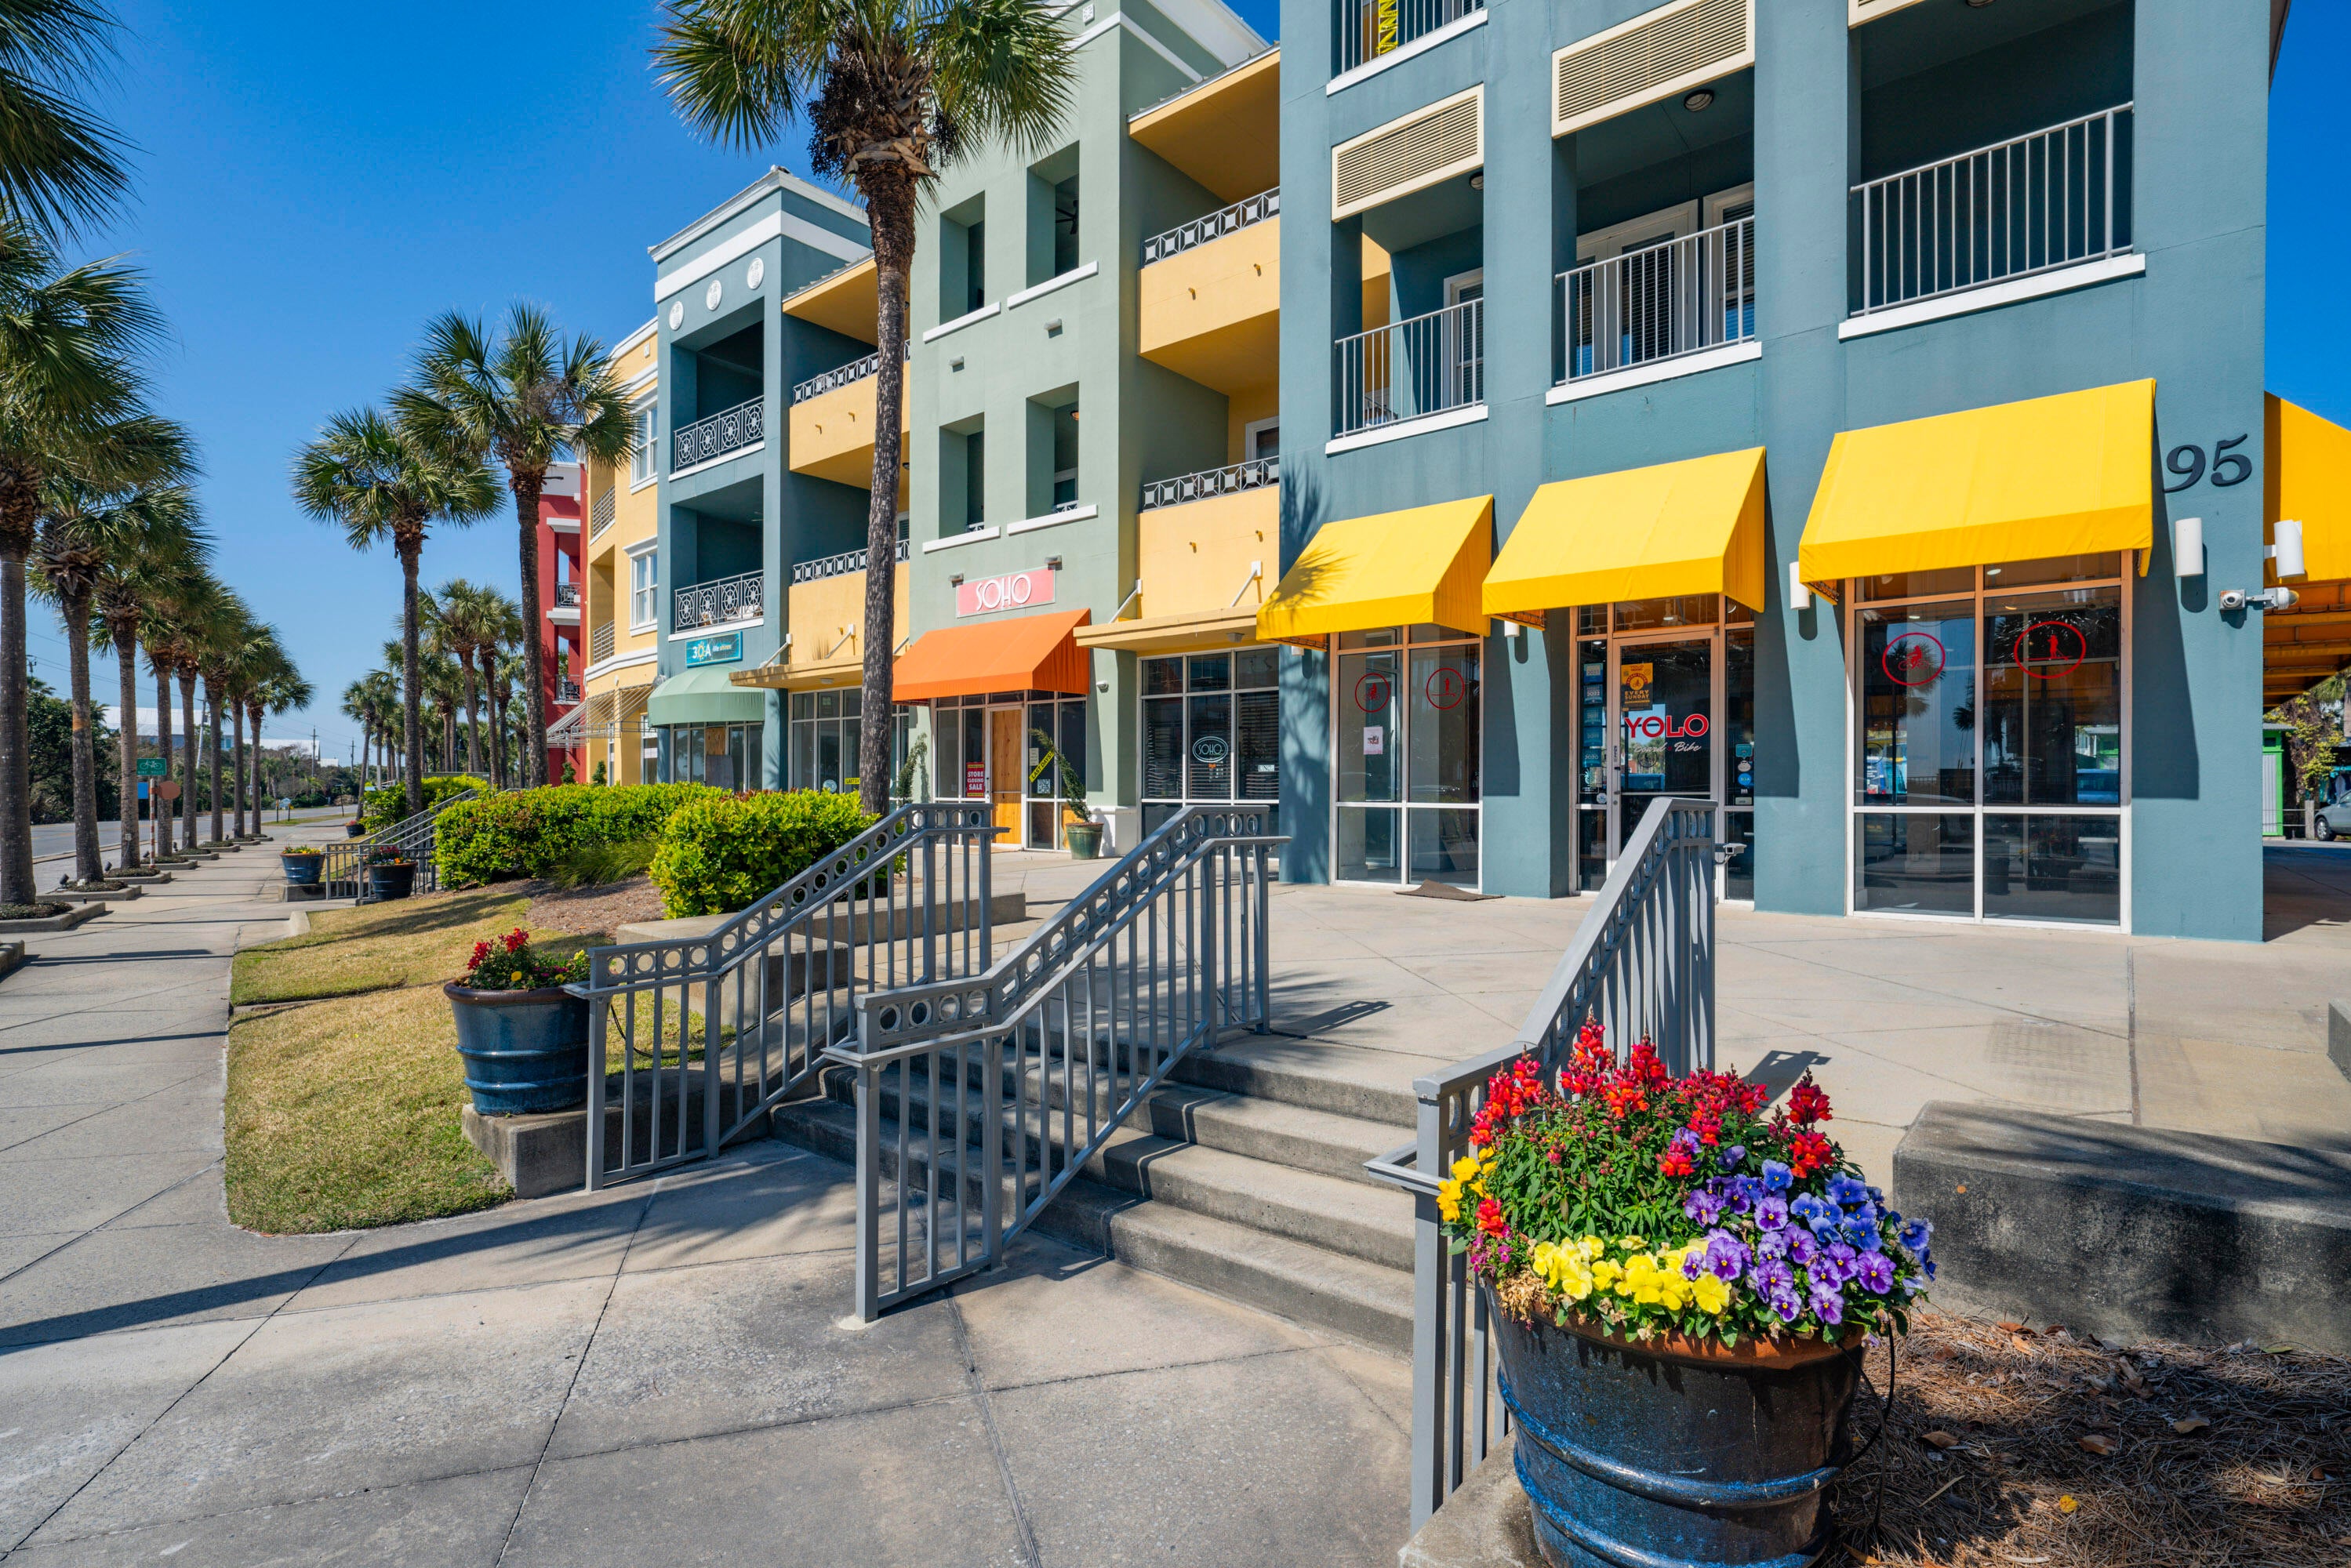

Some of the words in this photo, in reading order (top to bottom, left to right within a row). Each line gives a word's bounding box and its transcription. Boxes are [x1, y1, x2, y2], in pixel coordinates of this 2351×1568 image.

[2162, 433, 2252, 493] 95
[976, 574, 1032, 612] SOHO
[1624, 713, 1710, 738] YOLO
[1198, 744, 1223, 755] SOHO
[1633, 742, 1668, 753] Board
[1673, 741, 1702, 752] Bike
[1031, 766, 1041, 779] LAST
